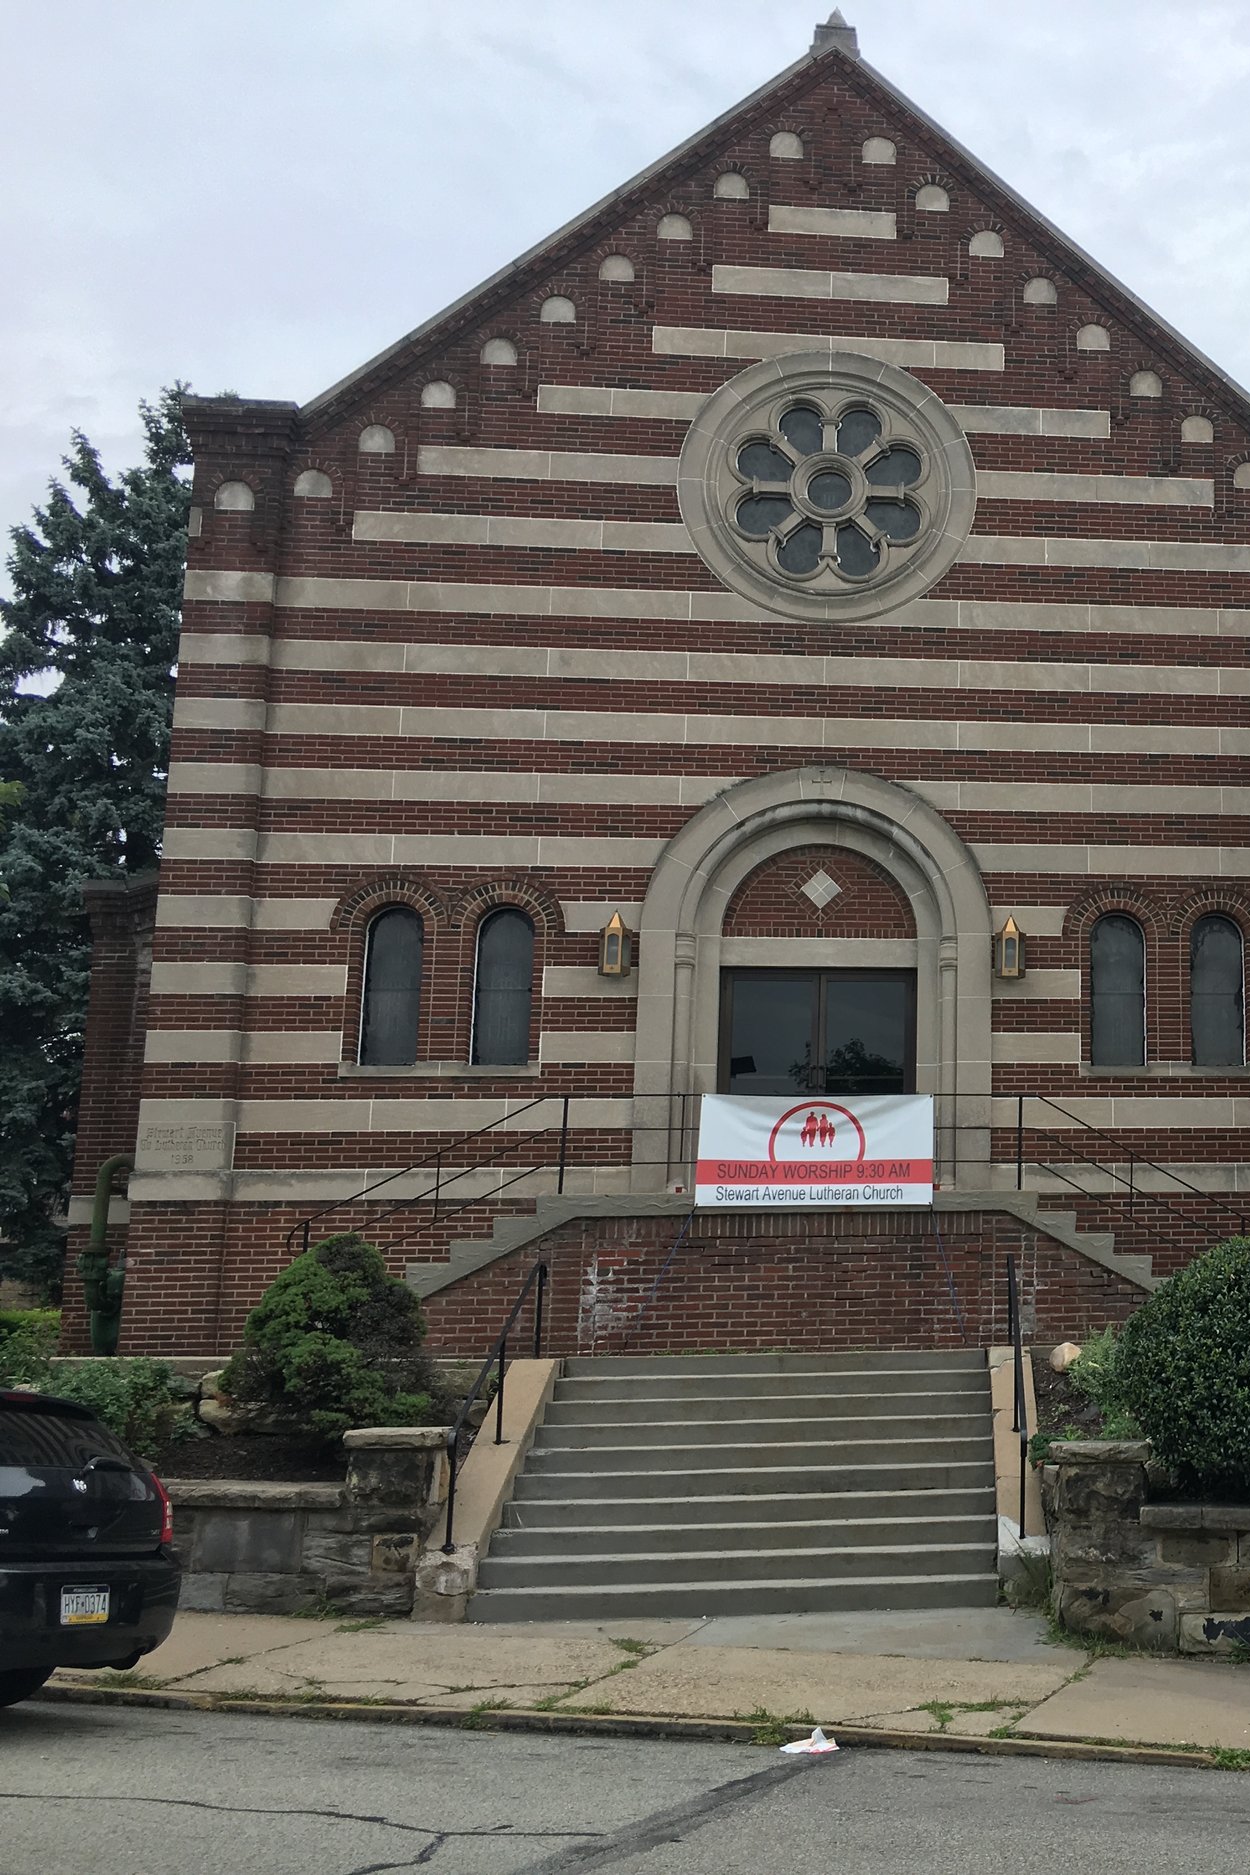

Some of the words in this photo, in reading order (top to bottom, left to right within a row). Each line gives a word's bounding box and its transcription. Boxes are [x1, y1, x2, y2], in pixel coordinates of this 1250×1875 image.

[717, 1163, 778, 1179] SUNDAY
[783, 1164, 853, 1179] WORSHIP
[857, 1163, 884, 1178] 9:30
[888, 1162, 911, 1178] AM
[716, 1185, 760, 1201] Stewart
[762, 1186, 806, 1201] Avenue
[809, 1185, 859, 1201] Lutheran
[862, 1184, 904, 1200] Church
